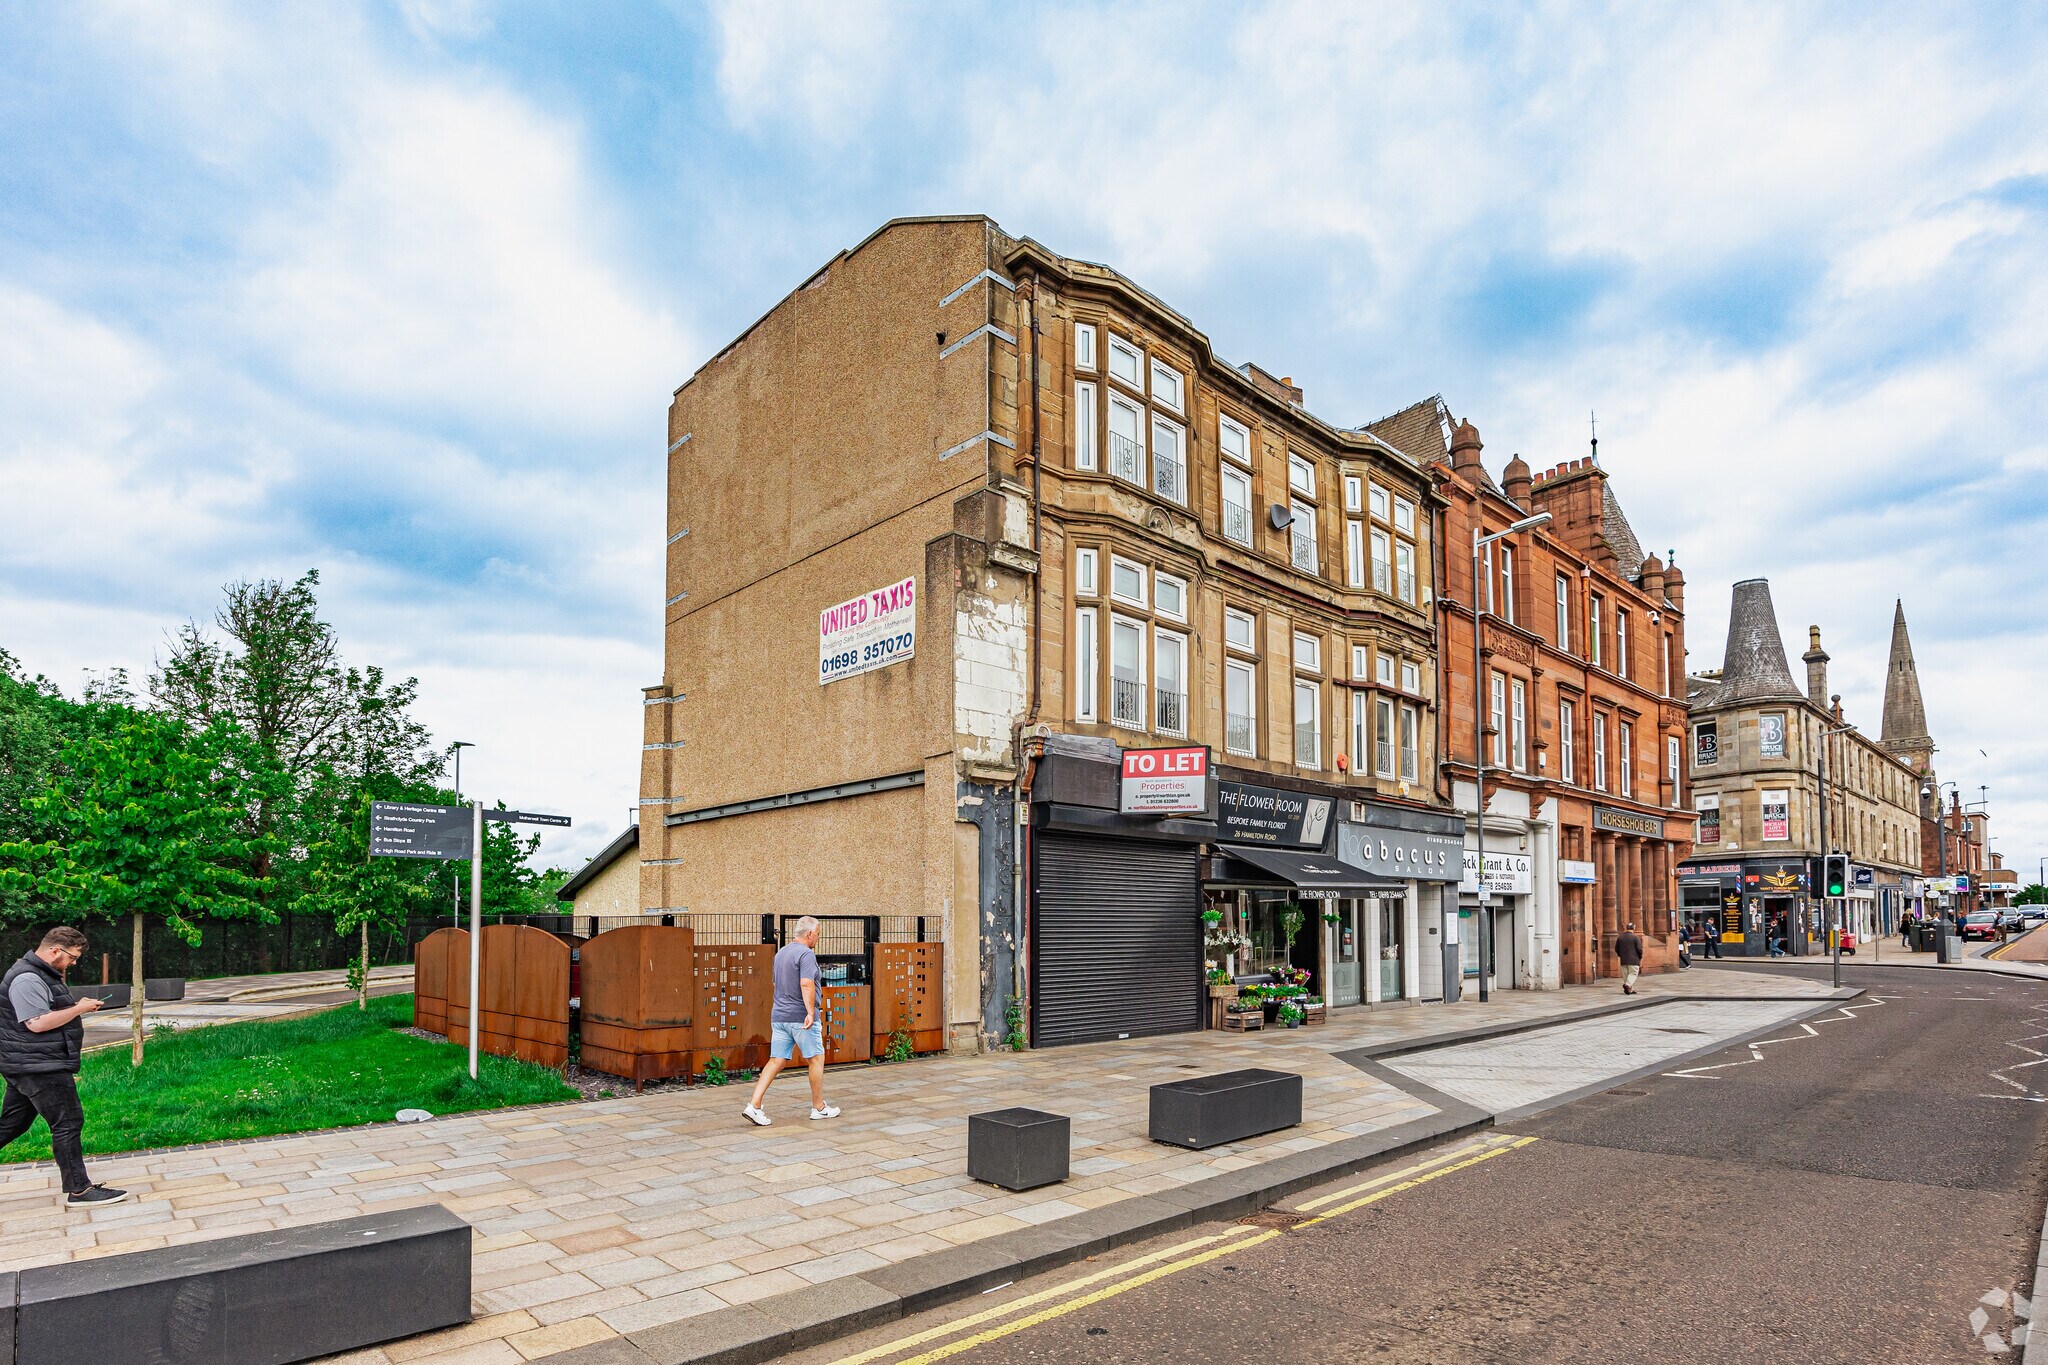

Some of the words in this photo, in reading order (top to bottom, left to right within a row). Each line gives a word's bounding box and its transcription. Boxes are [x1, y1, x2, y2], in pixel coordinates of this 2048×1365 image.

[822, 599, 867, 636] UNITED
[873, 581, 913, 617] TAXIS
[843, 636, 854, 644] Safe
[822, 650, 857, 673] 01698
[864, 632, 912, 661] 357070
[1126, 754, 1155, 773] TO
[1163, 753, 1203, 771] LET
[1141, 782, 1185, 791] Properties
[1220, 791, 1238, 805] THE
[1239, 794, 1274, 810] FLOWER
[1276, 799, 1302, 813] ROOM
[1227, 816, 1249, 826] BESPOKE
[1250, 818, 1267, 828] FAMILY
[1268, 821, 1287, 830] FLORIST
[1602, 813, 1644, 832] HORSESHOE
[1645, 822, 1657, 834] BAR
[1241, 831, 1264, 839] HAMILTON
[1364, 840, 1446, 865] abacus
[1395, 865, 1444, 874] SALON
[1463, 856, 1476, 869] ack
[1484, 859, 1502, 870] rant
[1506, 858, 1512, 871] &
[1516, 859, 1528, 872] Co.
[1700, 864, 1740, 874] BARBERS
